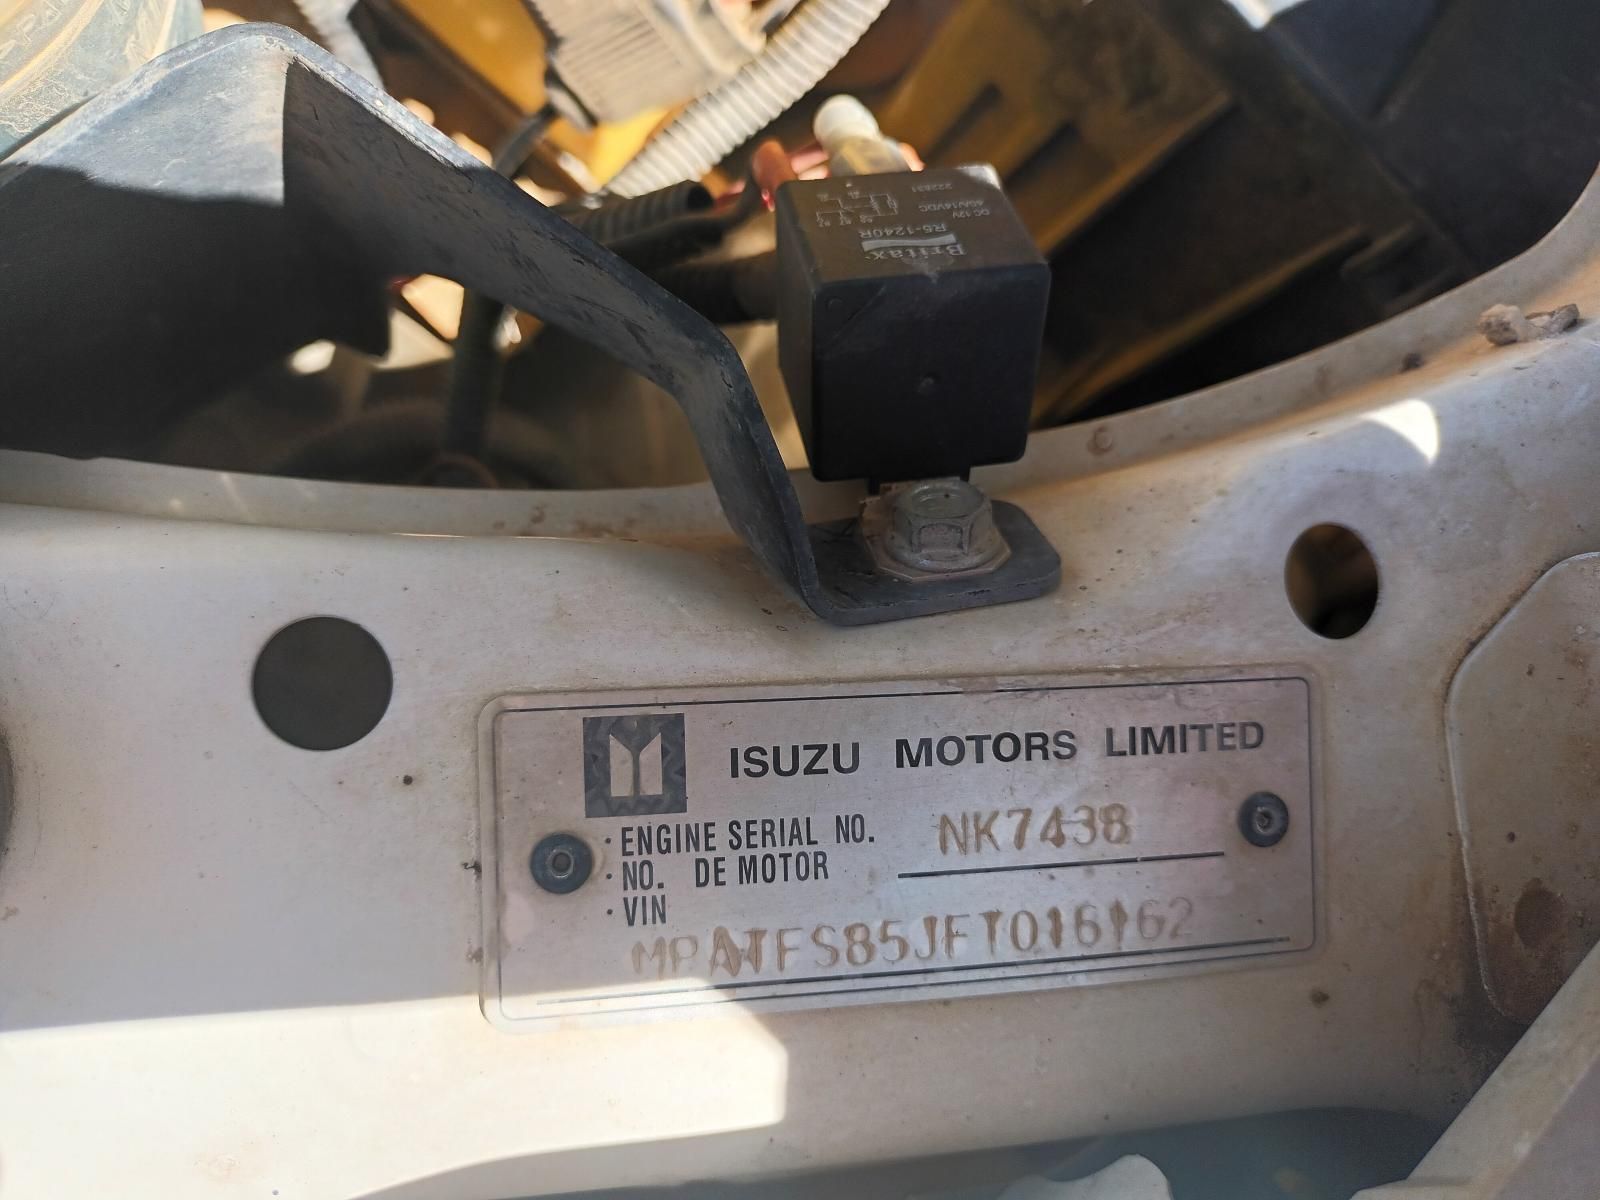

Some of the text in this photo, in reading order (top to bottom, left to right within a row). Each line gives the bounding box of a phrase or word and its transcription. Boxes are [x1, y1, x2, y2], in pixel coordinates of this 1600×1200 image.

[872, 244, 967, 261] Britax
[730, 721, 1265, 778] ISUZU MOTORS LIMITED
[621, 813, 875, 857] ENGINE SERIAL NO.
[938, 802, 1132, 856] NK7438
[623, 851, 829, 891] NO. DE MOTOR
[623, 895, 667, 927] VIN
